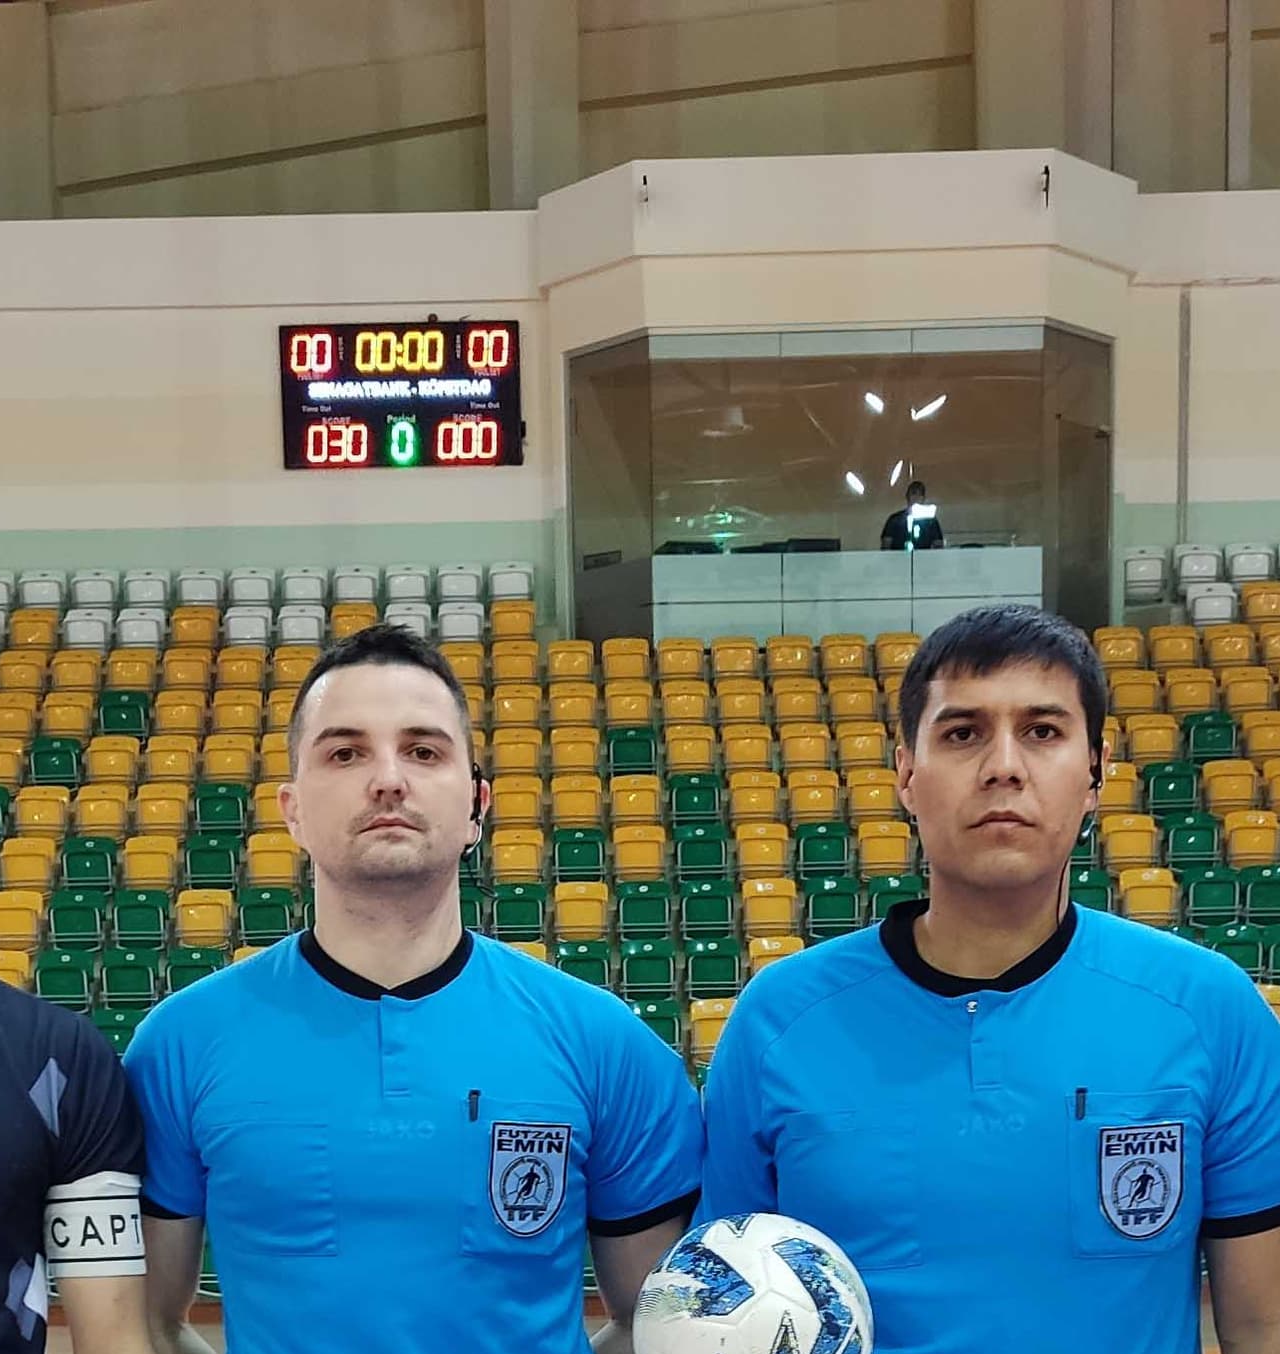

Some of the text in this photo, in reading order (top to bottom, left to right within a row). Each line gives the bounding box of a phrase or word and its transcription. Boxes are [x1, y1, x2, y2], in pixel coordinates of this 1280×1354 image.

[290, 333, 332, 373] 00
[355, 331, 444, 372] 00:00
[467, 329, 509, 368] 00
[307, 424, 368, 463] 030
[437, 421, 498, 460] 000
[496, 1138, 564, 1154] EMIN
[497, 1129, 565, 1140] FUTZAL
[1105, 1129, 1178, 1143] FUTZAL
[1105, 1139, 1177, 1157] EMIN
